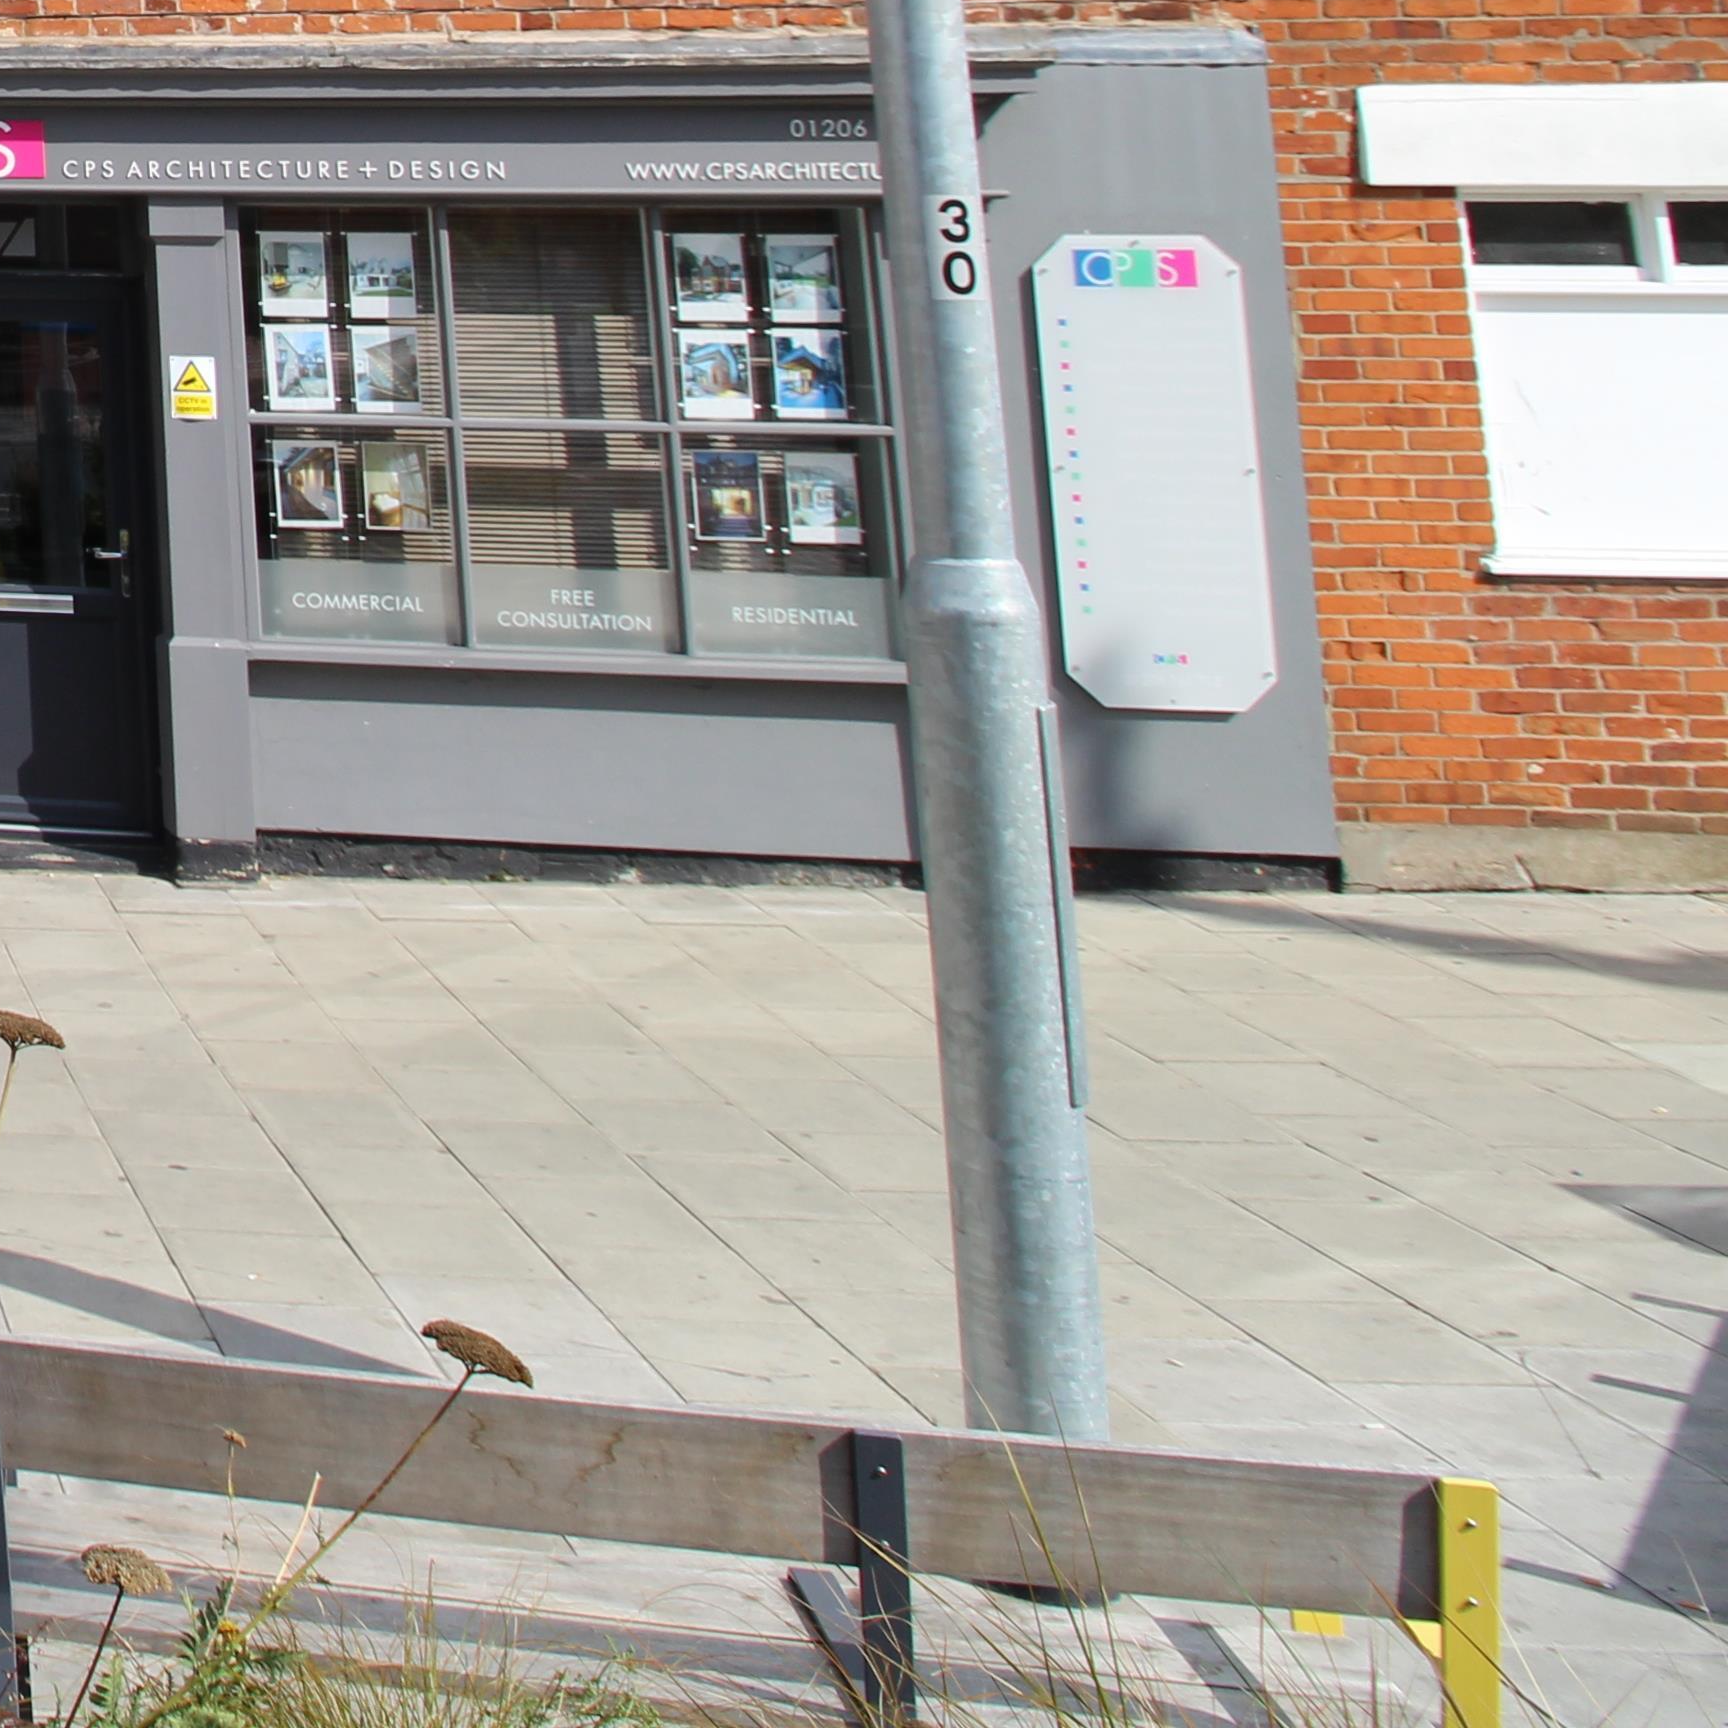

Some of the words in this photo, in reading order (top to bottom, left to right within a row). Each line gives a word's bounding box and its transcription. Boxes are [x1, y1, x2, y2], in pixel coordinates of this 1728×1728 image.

[789, 119, 868, 138] 01206
[62, 159, 115, 179] CPS
[127, 160, 349, 180] ARCHITECTURE
[388, 160, 506, 180] DESIGN
[1081, 251, 1179, 286] CPS
[292, 592, 424, 613] COMMERCIAL
[550, 589, 595, 607] FREE
[497, 610, 653, 632] CONSULTATION
[731, 606, 858, 627] RESIDENTIAL
